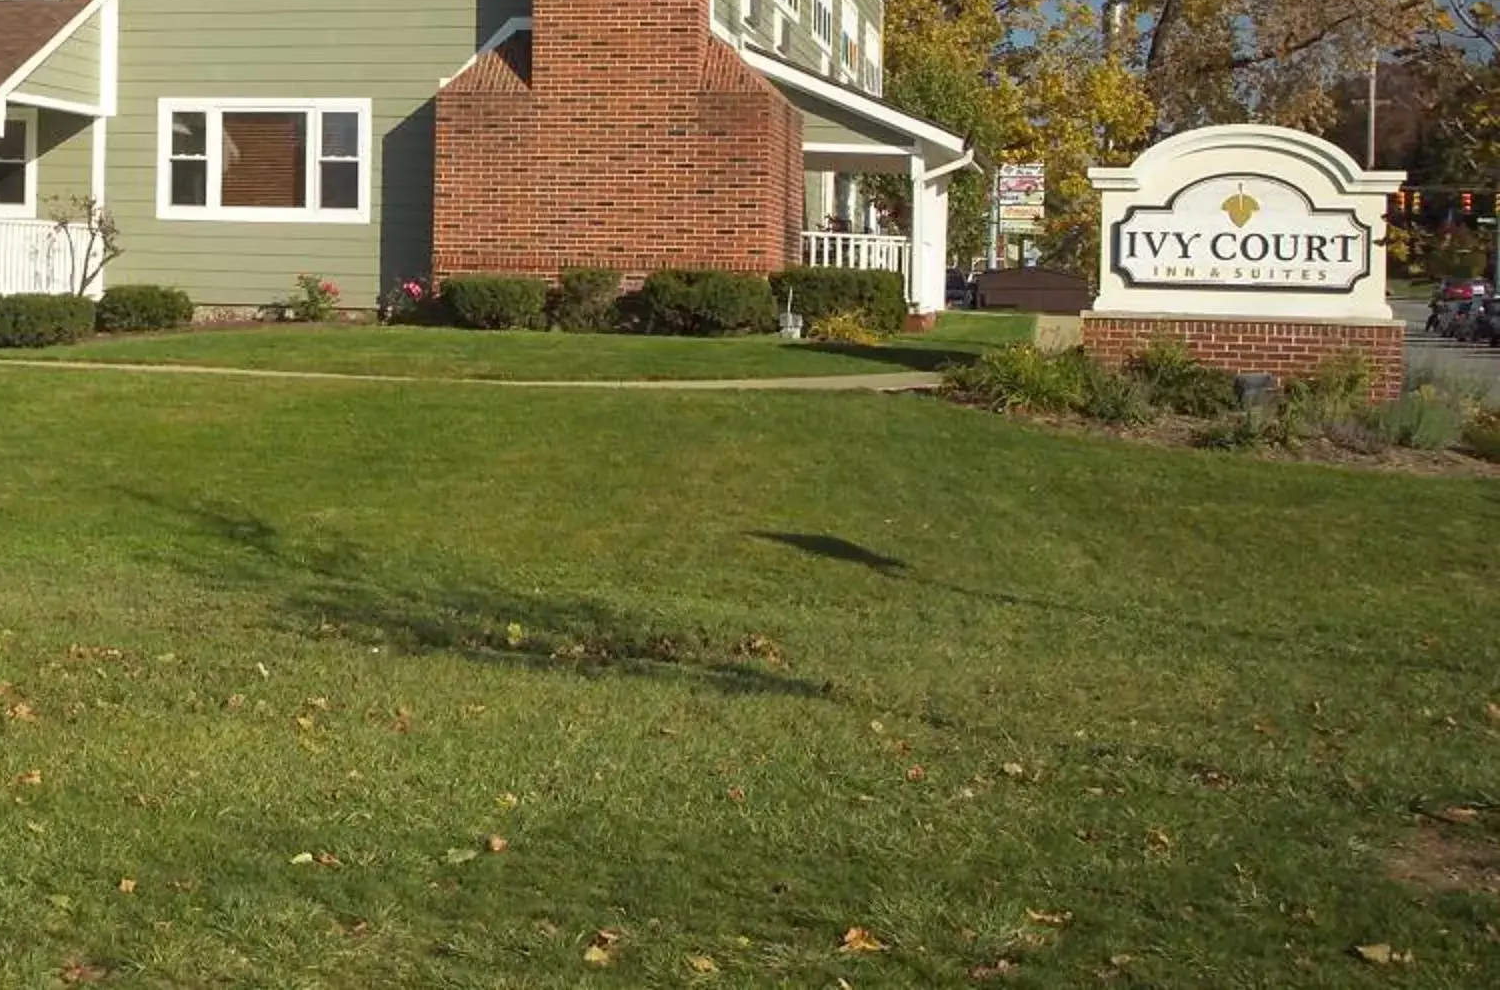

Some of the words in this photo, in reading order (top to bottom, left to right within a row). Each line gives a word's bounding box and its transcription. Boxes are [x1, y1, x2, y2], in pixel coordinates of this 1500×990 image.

[1126, 231, 1203, 259] IVY
[1210, 232, 1361, 263] COURT
[1153, 265, 1196, 278] INN
[1209, 266, 1221, 278] &
[1233, 267, 1328, 281] SUITES
